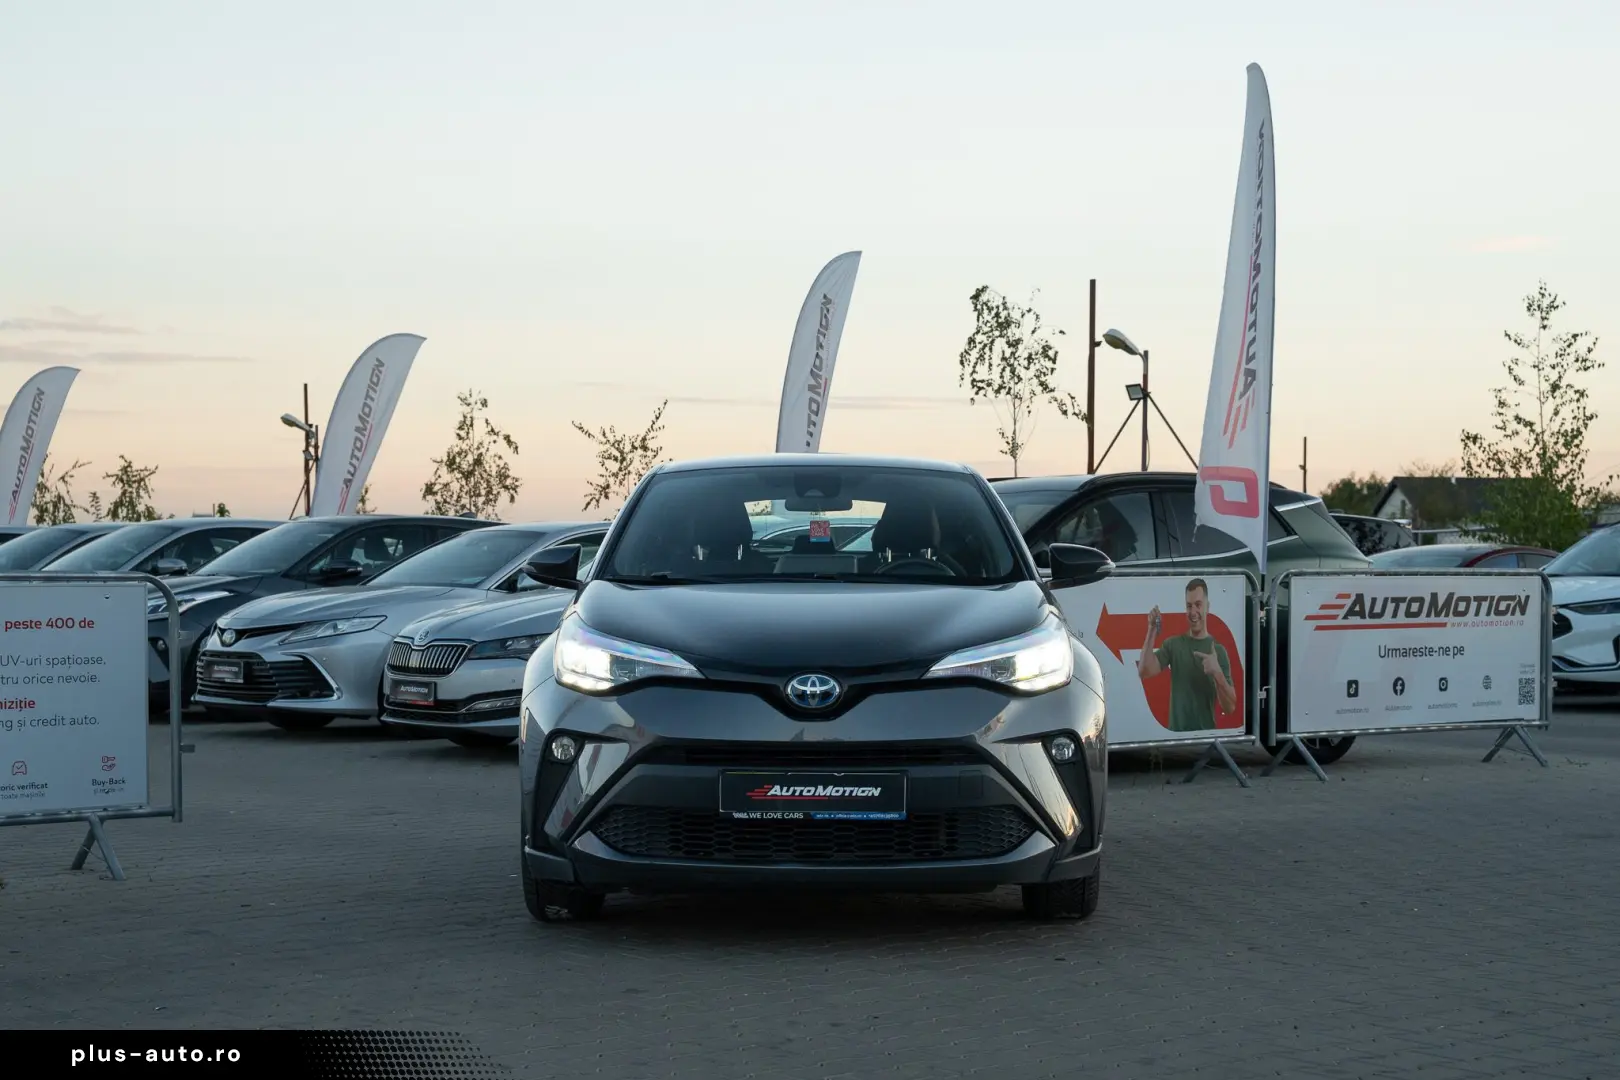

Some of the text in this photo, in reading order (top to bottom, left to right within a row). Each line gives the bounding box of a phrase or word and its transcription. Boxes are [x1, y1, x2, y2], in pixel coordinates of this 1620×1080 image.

[1341, 592, 1532, 620] AUTOMOTION
[4, 616, 95, 632] peste 400 de
[1450, 619, 1525, 628] www.automotion.ro
[1377, 644, 1465, 660] Urmareste-ne pe
[0, 671, 101, 685] tru orice nevoie.
[17, 716, 26, 731] și
[29, 714, 66, 727] credit
[69, 715, 100, 726] auto.
[17, 781, 48, 790] verificat
[91, 777, 126, 787] Buy-Back
[766, 784, 882, 797] AUTOMOTION
